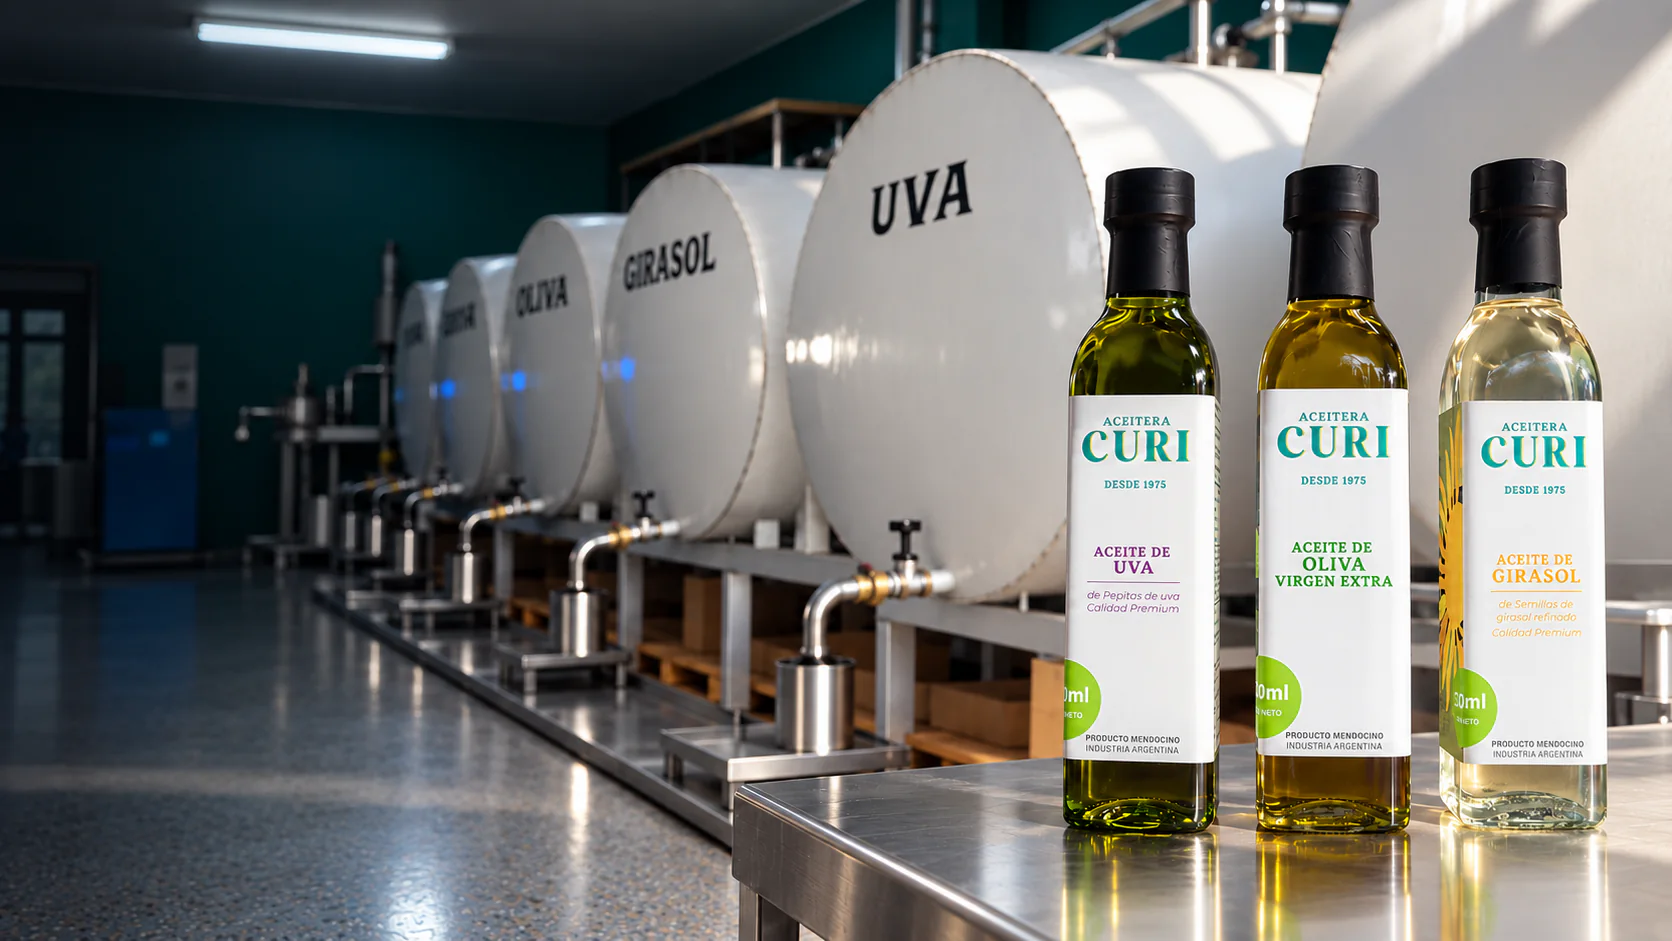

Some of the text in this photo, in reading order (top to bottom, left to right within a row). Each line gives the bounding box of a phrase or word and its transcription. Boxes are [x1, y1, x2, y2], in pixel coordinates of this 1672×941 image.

[871, 160, 972, 235] UVA
[624, 232, 716, 291] GIRASOL
[515, 276, 568, 318] OLIVA
[1103, 416, 1171, 426] ACEITERA
[1299, 412, 1369, 421] ACEITERA
[1501, 422, 1567, 432] ACEITERA
[1082, 430, 1190, 462] CURI
[1277, 426, 1390, 458] CURI
[1481, 436, 1586, 468] CURI
[1104, 480, 1167, 489] DESDE 1975
[1301, 476, 1366, 485] DESDE 1975
[1504, 486, 1565, 494] DESDE 1975
[1093, 547, 1171, 557] ACEITE DE
[1291, 542, 1372, 553] ACEITE DE
[1302, 557, 1366, 572] OLIVA
[1496, 554, 1573, 565] ACEITE DE
[1114, 561, 1154, 574] UVA
[1275, 575, 1393, 587] VIRGEN EXTRA
[1492, 569, 1581, 583] GIRASOL
[1087, 591, 1180, 601] de Pepitas de uva
[1087, 603, 1180, 613] Calidad Premium
[1499, 600, 1573, 609] de Semillas de
[1496, 613, 1577, 624] girasol refinado
[1492, 628, 1581, 638] Calidad Premium
[1085, 734, 1180, 744] PRODUCTO MENDOCINO
[1492, 740, 1584, 748] PRODUCTO MENDOCINO
[1085, 744, 1179, 754] INDUSTRIA ARGENTINA
[1493, 750, 1583, 758] INDUSTRIA ARGENTINA
